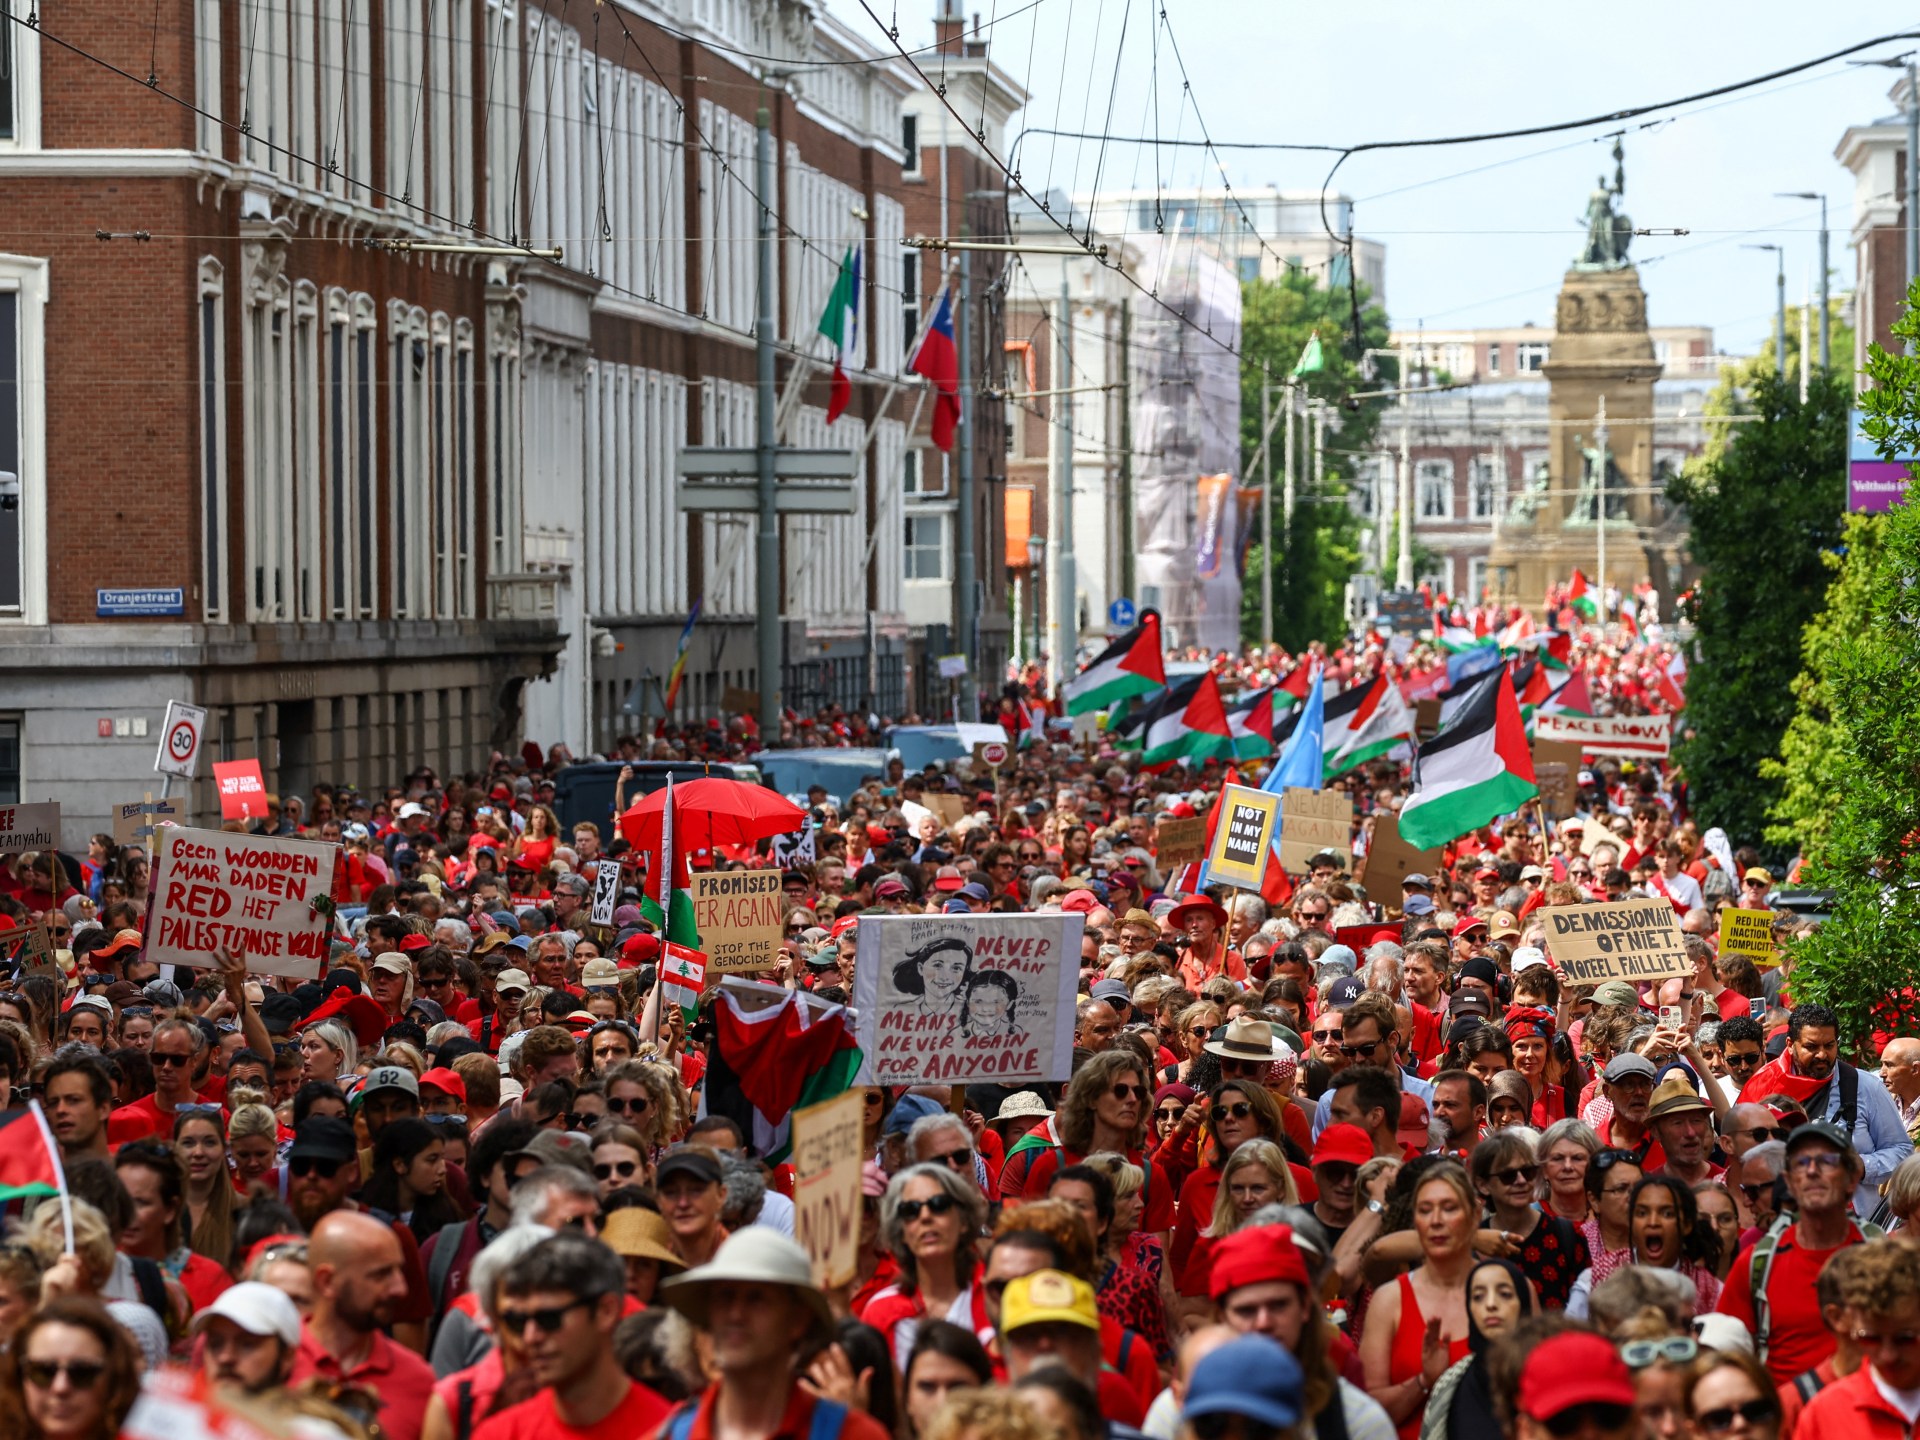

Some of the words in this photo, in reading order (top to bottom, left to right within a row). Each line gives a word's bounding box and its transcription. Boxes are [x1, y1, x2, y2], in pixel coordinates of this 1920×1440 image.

[104, 593, 176, 606] Oranjestraat
[180, 708, 196, 719] ZONE
[1538, 717, 1603, 734] PEACE
[174, 731, 192, 750] 30
[1237, 806, 1262, 821] NOT
[1287, 794, 1343, 816] NEVER
[1231, 821, 1242, 834] IN
[1244, 824, 1262, 838] MY
[1285, 818, 1343, 840] AGAIN
[1228, 837, 1258, 854] NAME
[225, 847, 318, 876] WOORDEN
[169, 860, 221, 883] MAAR
[230, 869, 307, 902] DADEN
[166, 882, 231, 918] RED
[241, 896, 280, 920] HET
[593, 906, 611, 921] NOW
[1736, 915, 1752, 926] RED
[1754, 917, 1771, 928] LINE
[911, 920, 934, 932] ANNE
[1730, 927, 1768, 939] INACTION
[158, 916, 283, 958] PALESTIJNSE
[911, 929, 937, 943] FRANK
[1597, 933, 1623, 952] OF
[714, 942, 743, 955] STOP
[748, 941, 770, 952] THE
[975, 936, 1050, 957] NEVER
[880, 1010, 957, 1031] MEANS
[879, 1034, 954, 1051] NEVER
[877, 1056, 918, 1073] FOR
[922, 1049, 1039, 1079] ANYONE
[380, 1070, 399, 1085] 52
[803, 1185, 856, 1262] NOW
